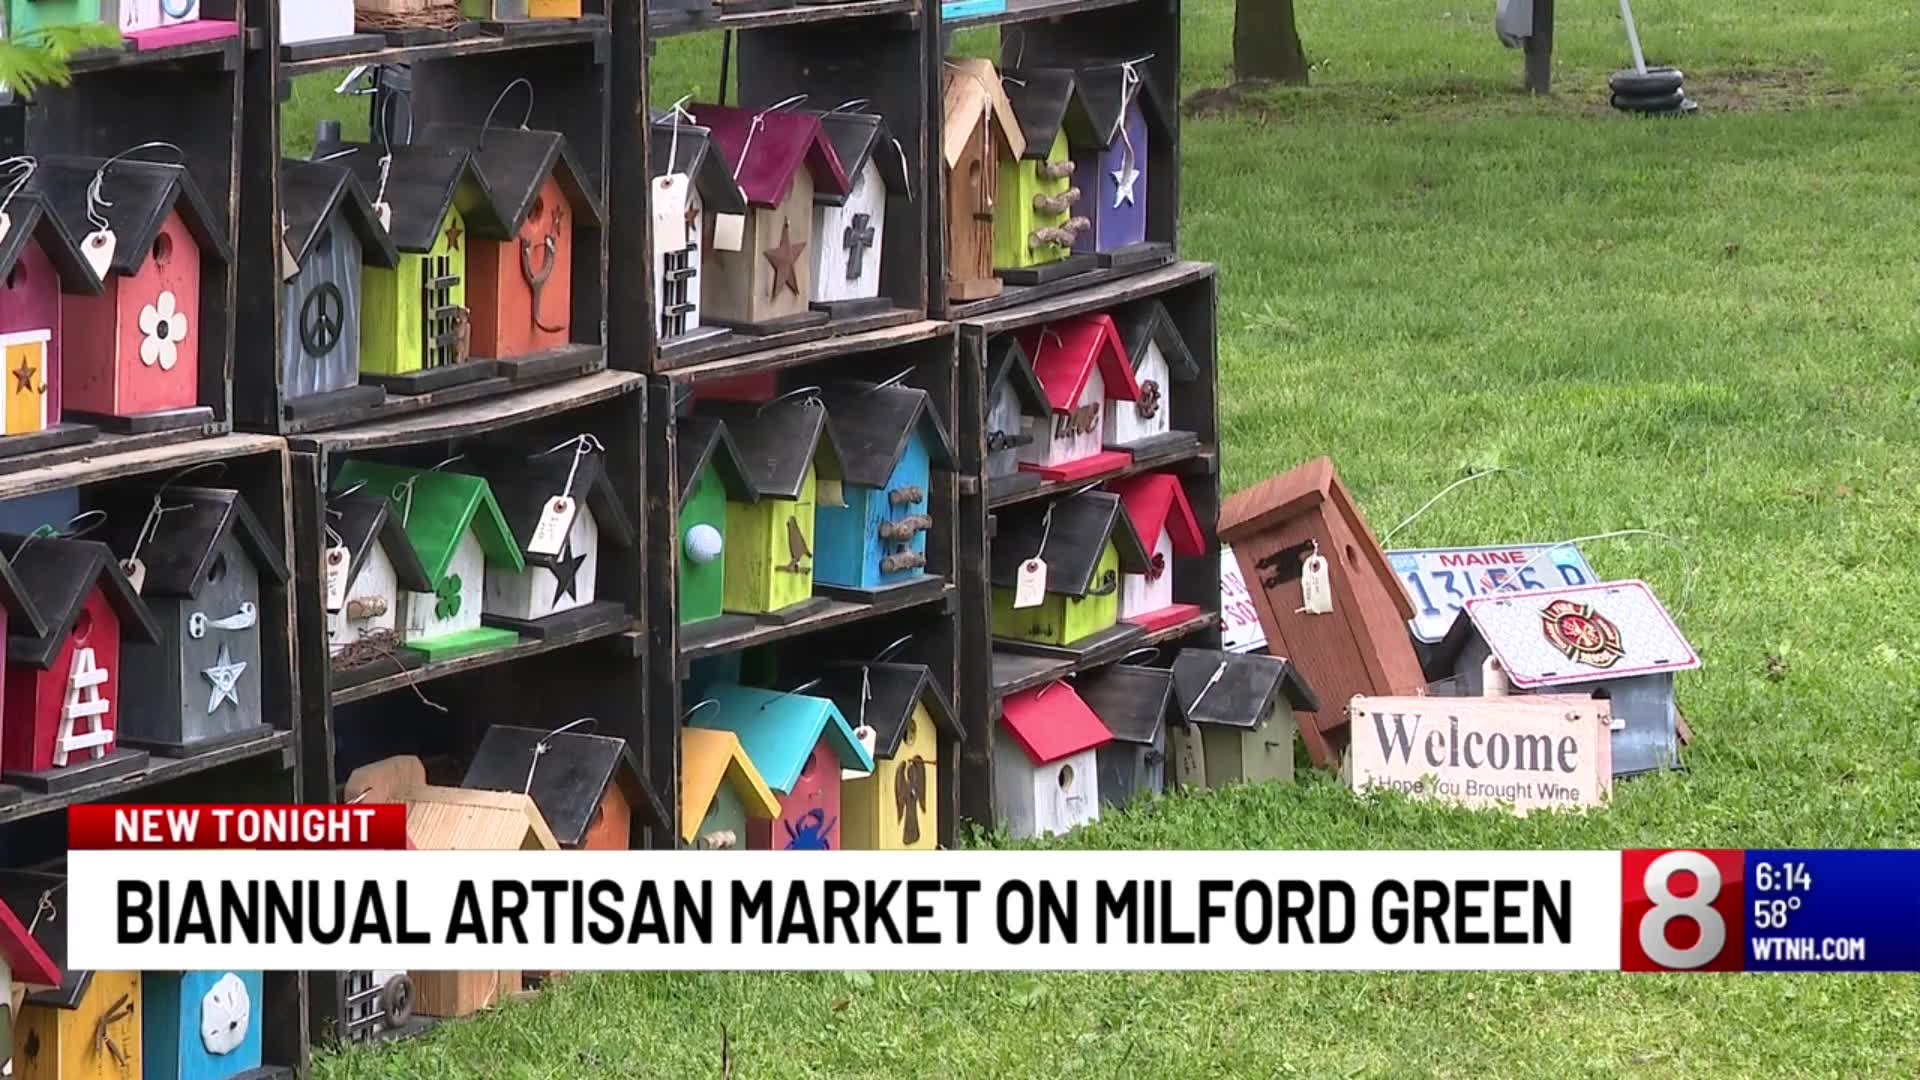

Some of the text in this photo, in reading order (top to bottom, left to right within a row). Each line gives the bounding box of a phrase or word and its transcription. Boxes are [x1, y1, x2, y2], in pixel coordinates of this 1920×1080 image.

[1439, 551, 1528, 567] MAINE
[1371, 712, 1579, 774] Welcome
[1378, 775, 1424, 794] Hope
[1430, 777, 1460, 796] You
[1465, 779, 1533, 801] Brought
[1537, 782, 1581, 802] Wine
